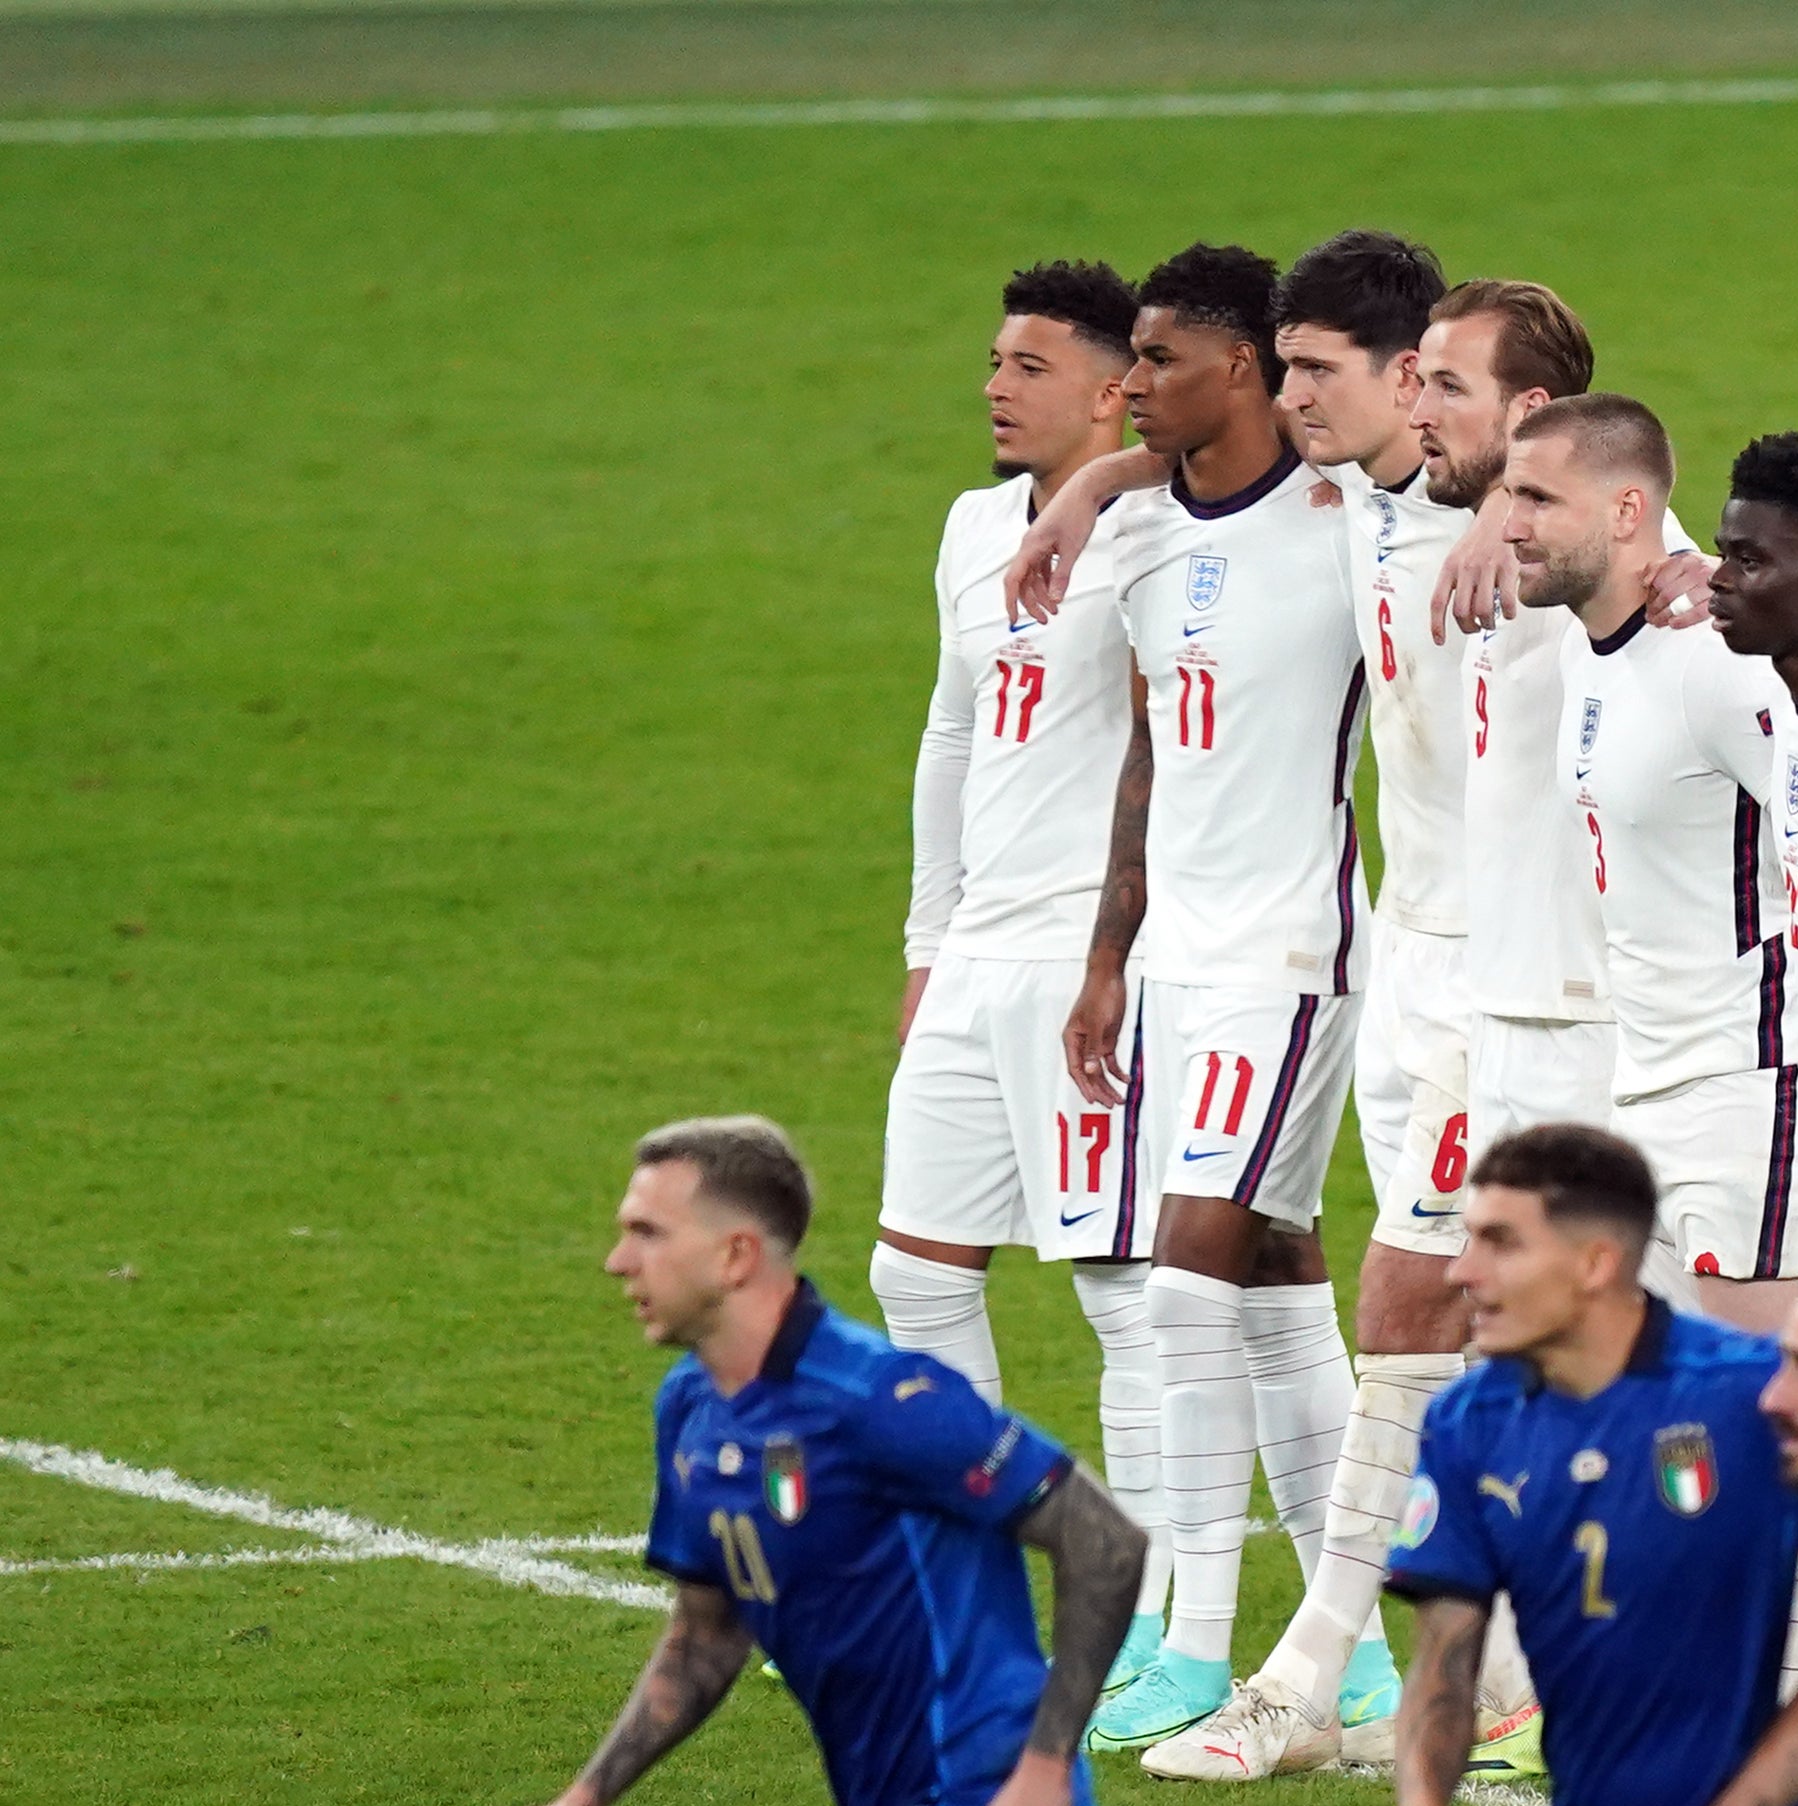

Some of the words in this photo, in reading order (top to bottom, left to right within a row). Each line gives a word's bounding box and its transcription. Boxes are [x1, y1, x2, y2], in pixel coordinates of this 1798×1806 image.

[1378, 597, 1398, 682] 6
[993, 658, 1046, 743] 17
[1177, 665, 1215, 750] 11
[1475, 675, 1489, 759] 9
[1587, 811, 1607, 894] 3
[1194, 1051, 1255, 1137] 11
[1056, 1110, 1111, 1193] 17
[1430, 1111, 1468, 1194] 6
[1573, 1518, 1618, 1620] 2
